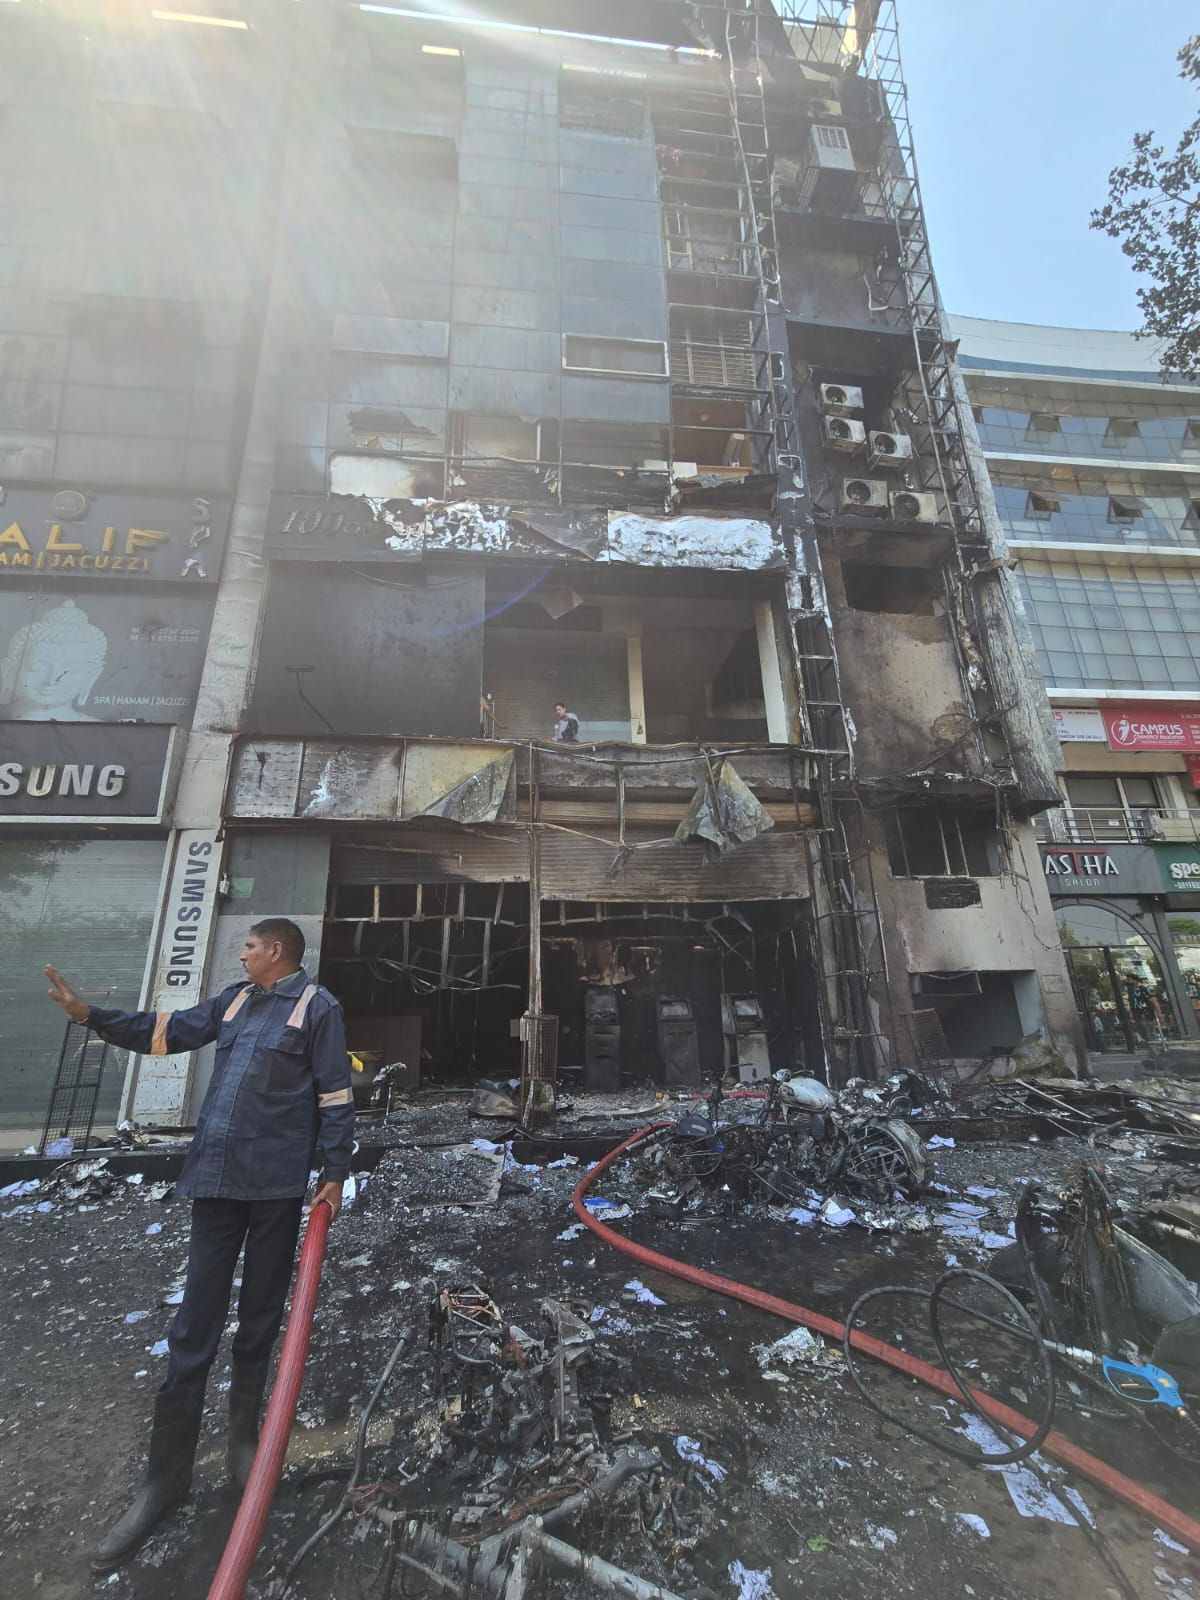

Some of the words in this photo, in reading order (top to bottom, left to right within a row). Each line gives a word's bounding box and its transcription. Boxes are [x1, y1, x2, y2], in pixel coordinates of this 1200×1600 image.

[50, 553, 151, 571] JACUZZI
[116, 695, 149, 705] HAMAM
[1130, 723, 1184, 735] CAMPUS
[0, 762, 126, 797] SUNG
[1045, 848, 1119, 876] ASTHA
[166, 840, 212, 987] SAMSUNG
